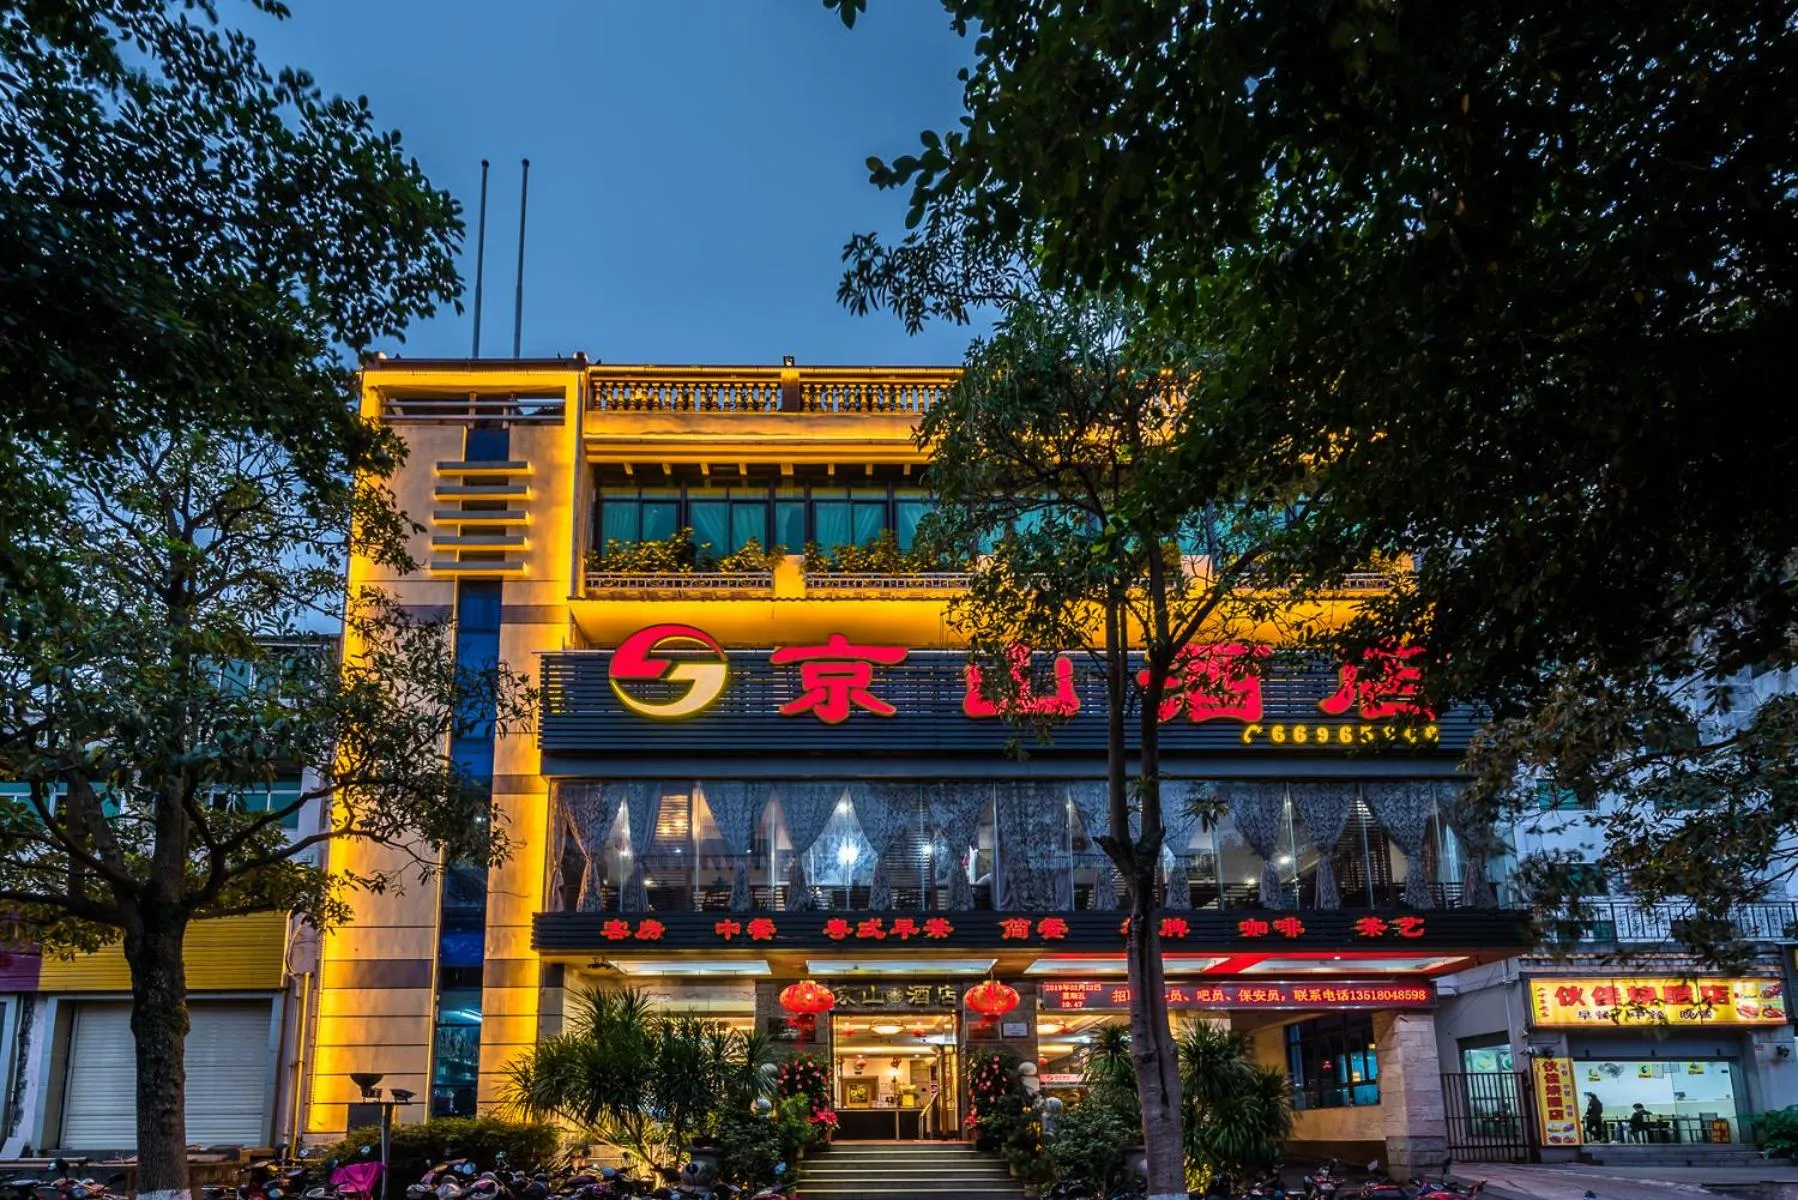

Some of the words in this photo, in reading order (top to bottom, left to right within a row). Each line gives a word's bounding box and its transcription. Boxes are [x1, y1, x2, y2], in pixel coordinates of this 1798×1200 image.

[769, 633, 1435, 724] 京山酒店
[599, 918, 666, 941] 客房
[714, 918, 777, 941] 中餐
[822, 917, 954, 940] 粤式早茶
[998, 917, 1070, 940] 简餐
[1119, 916, 1191, 938] 牌
[1237, 916, 1306, 938] 咖啡
[1354, 916, 1426, 938] 茶艺
[832, 984, 958, 1006] 京山酒店
